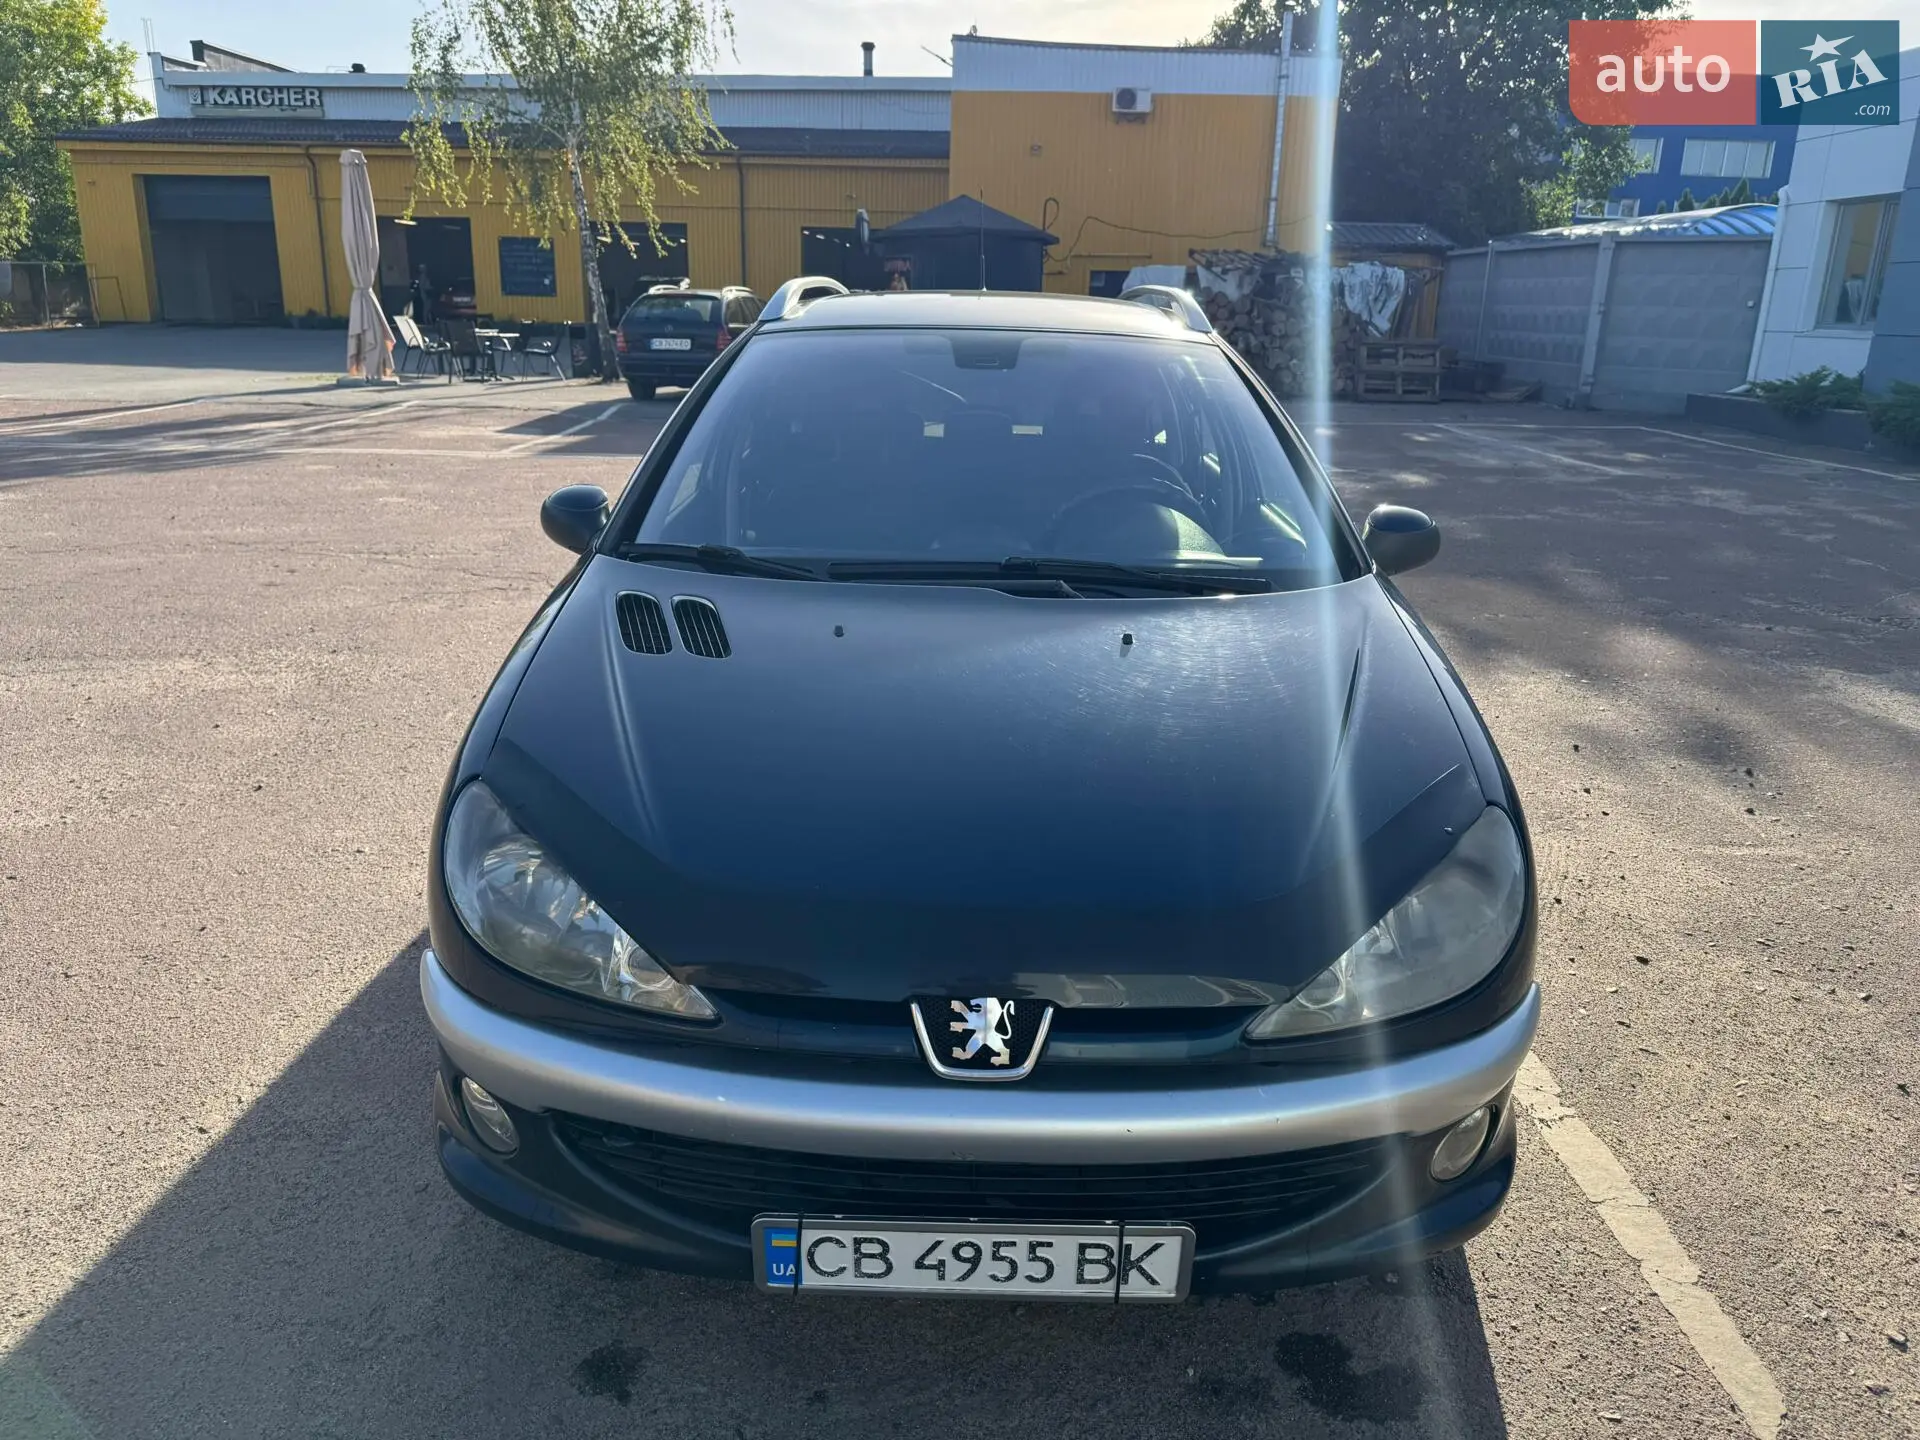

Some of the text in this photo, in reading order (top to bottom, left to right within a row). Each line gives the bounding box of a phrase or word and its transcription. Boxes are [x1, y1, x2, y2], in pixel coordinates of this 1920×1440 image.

[772, 1263, 797, 1277] UA
[806, 1236, 1166, 1286] CB 4955 BK
